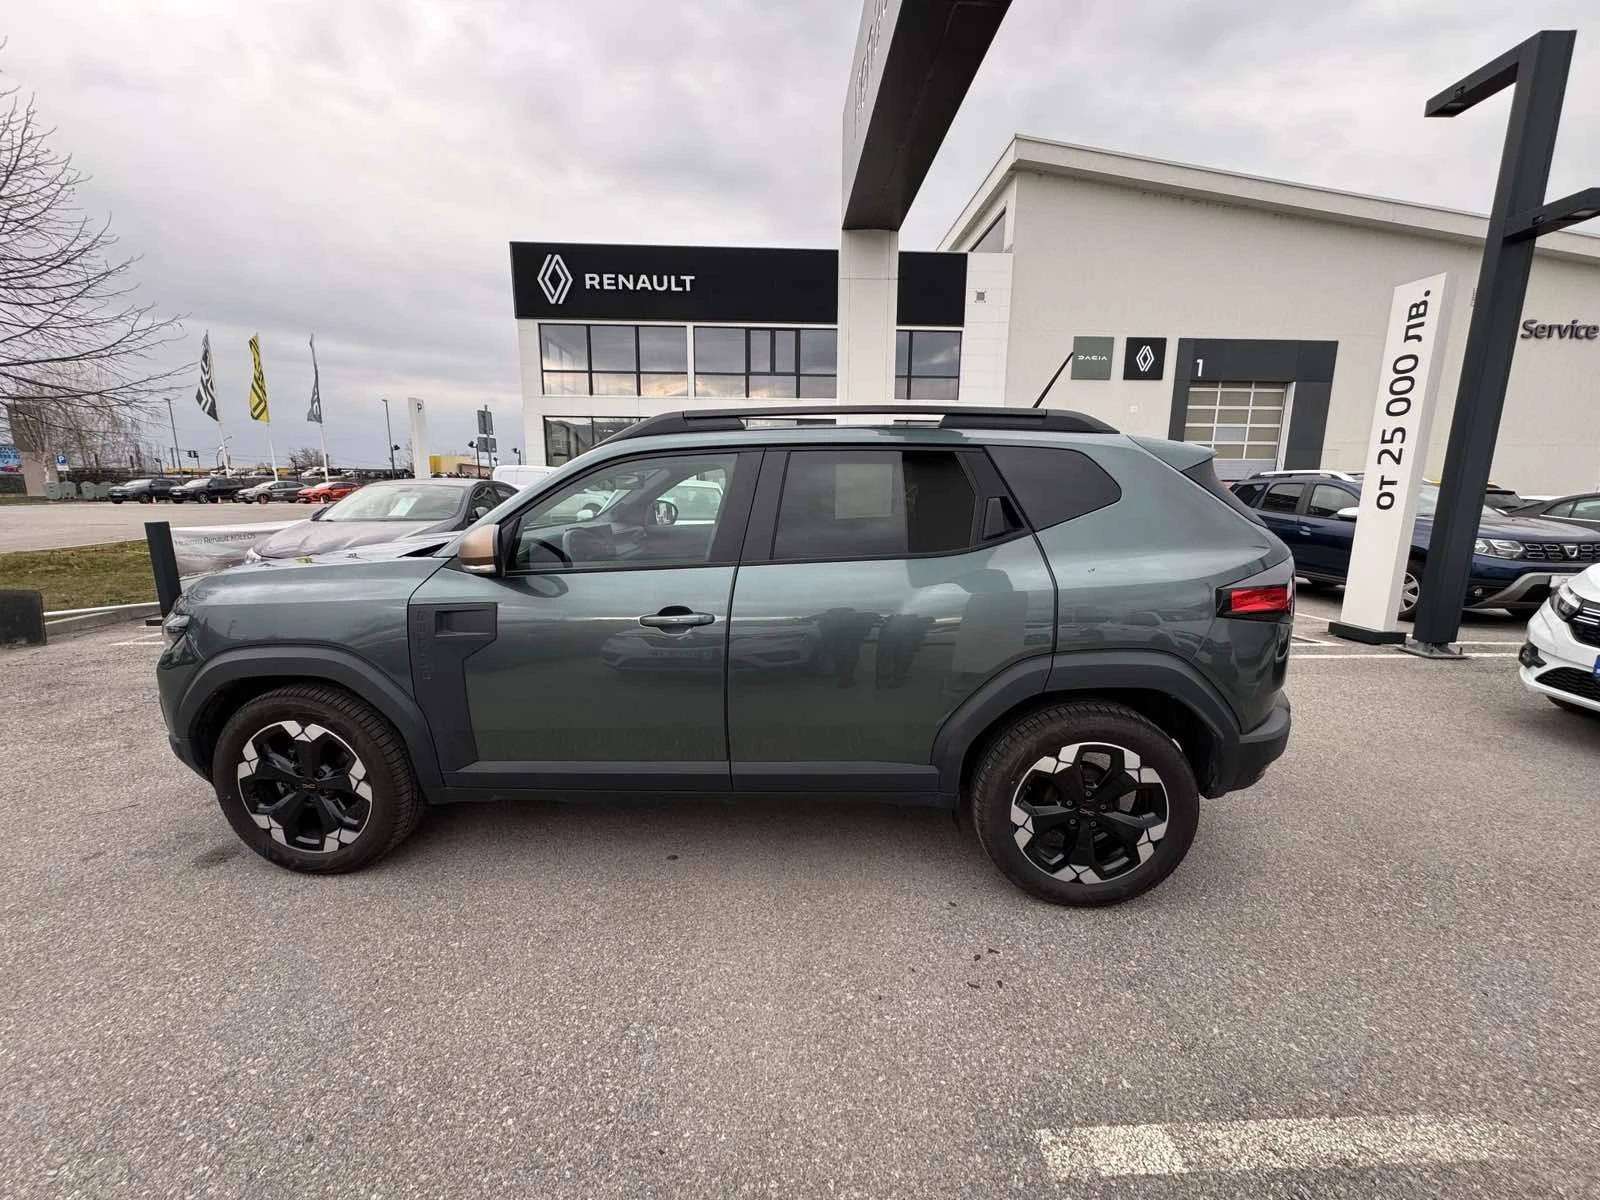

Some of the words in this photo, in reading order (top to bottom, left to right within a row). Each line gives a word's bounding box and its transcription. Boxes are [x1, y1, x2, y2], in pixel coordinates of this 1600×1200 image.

[585, 273, 695, 292] RENAULT
[1521, 319, 1600, 339] Service
[1196, 359, 1203, 377] 1
[1383, 354, 1419, 416] 000
[1377, 427, 1406, 465] 25
